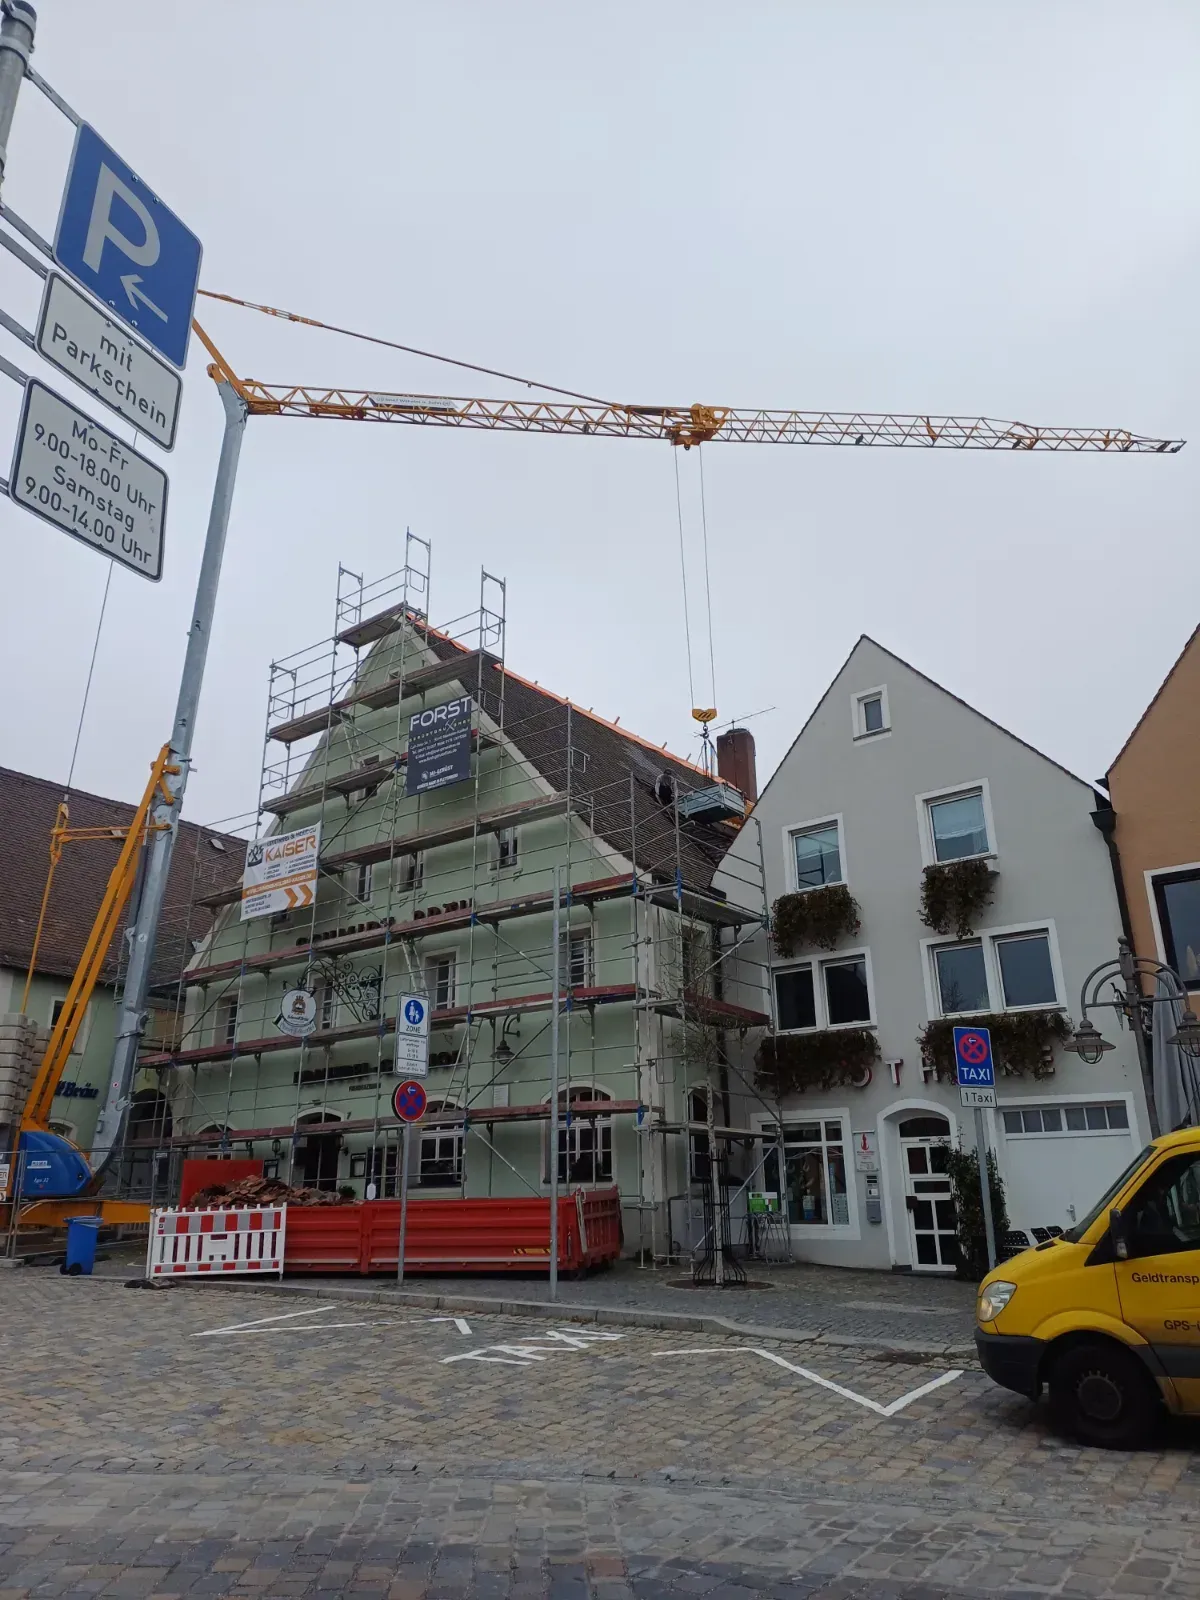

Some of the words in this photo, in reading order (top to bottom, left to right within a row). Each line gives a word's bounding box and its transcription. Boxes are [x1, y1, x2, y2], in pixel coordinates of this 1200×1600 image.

[83, 161, 161, 274] P
[99, 334, 133, 372] mit
[51, 322, 166, 428] Parkschein
[71, 420, 129, 471] Mo-Fr
[34, 423, 121, 493] 9.00-18.00
[126, 483, 156, 515] Uhr
[52, 465, 135, 533] Samstag
[25, 476, 115, 543] 9.00-14.00
[121, 533, 152, 564] Uhr
[409, 695, 472, 732] FORST
[265, 834, 316, 864] KAISER
[405, 1024, 421, 1034] ZONE
[960, 1067, 991, 1081] TAXI
[964, 1092, 969, 1102] 1
[971, 1092, 993, 1103] Taxi
[1131, 1272, 1200, 1285] Geldtransp
